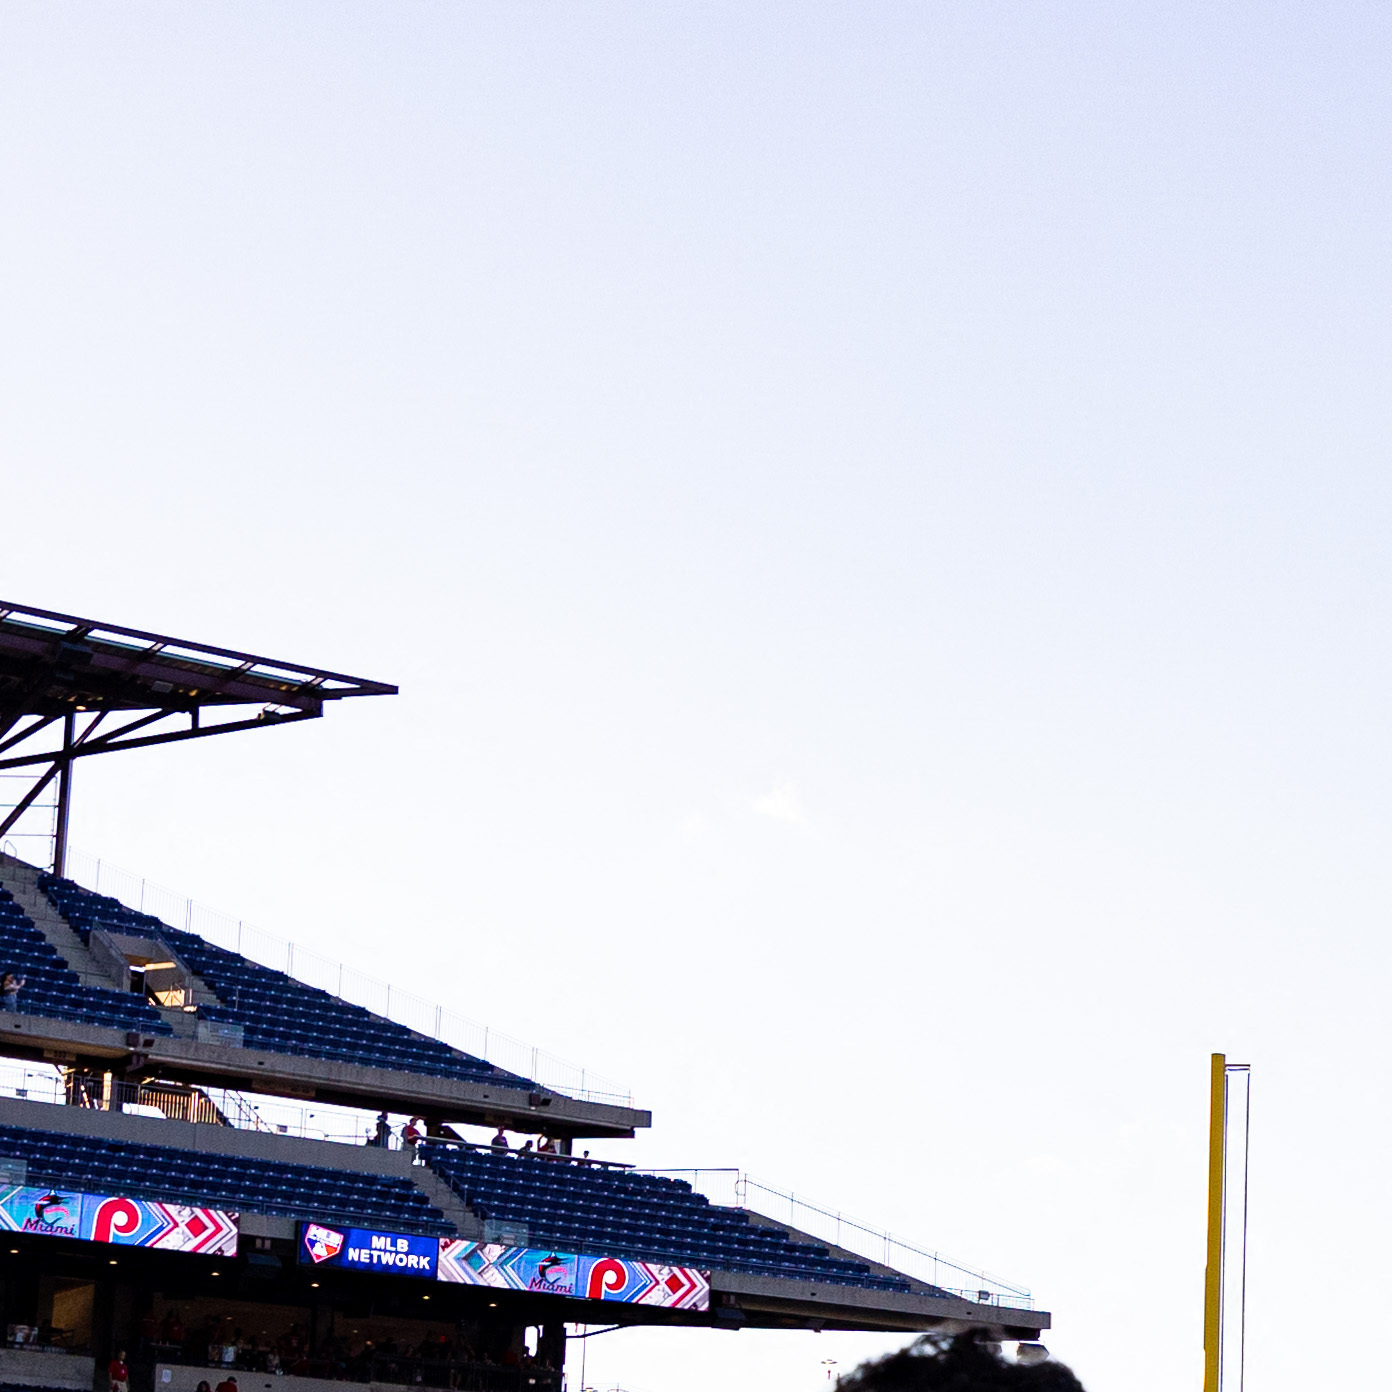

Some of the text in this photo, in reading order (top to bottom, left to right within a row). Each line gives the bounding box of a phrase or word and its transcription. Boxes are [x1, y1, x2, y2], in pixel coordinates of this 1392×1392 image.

[22, 1217, 76, 1236] Miami
[371, 1235, 409, 1252] MLB
[347, 1247, 431, 1270] NETWORK
[528, 1277, 574, 1295] Miami
